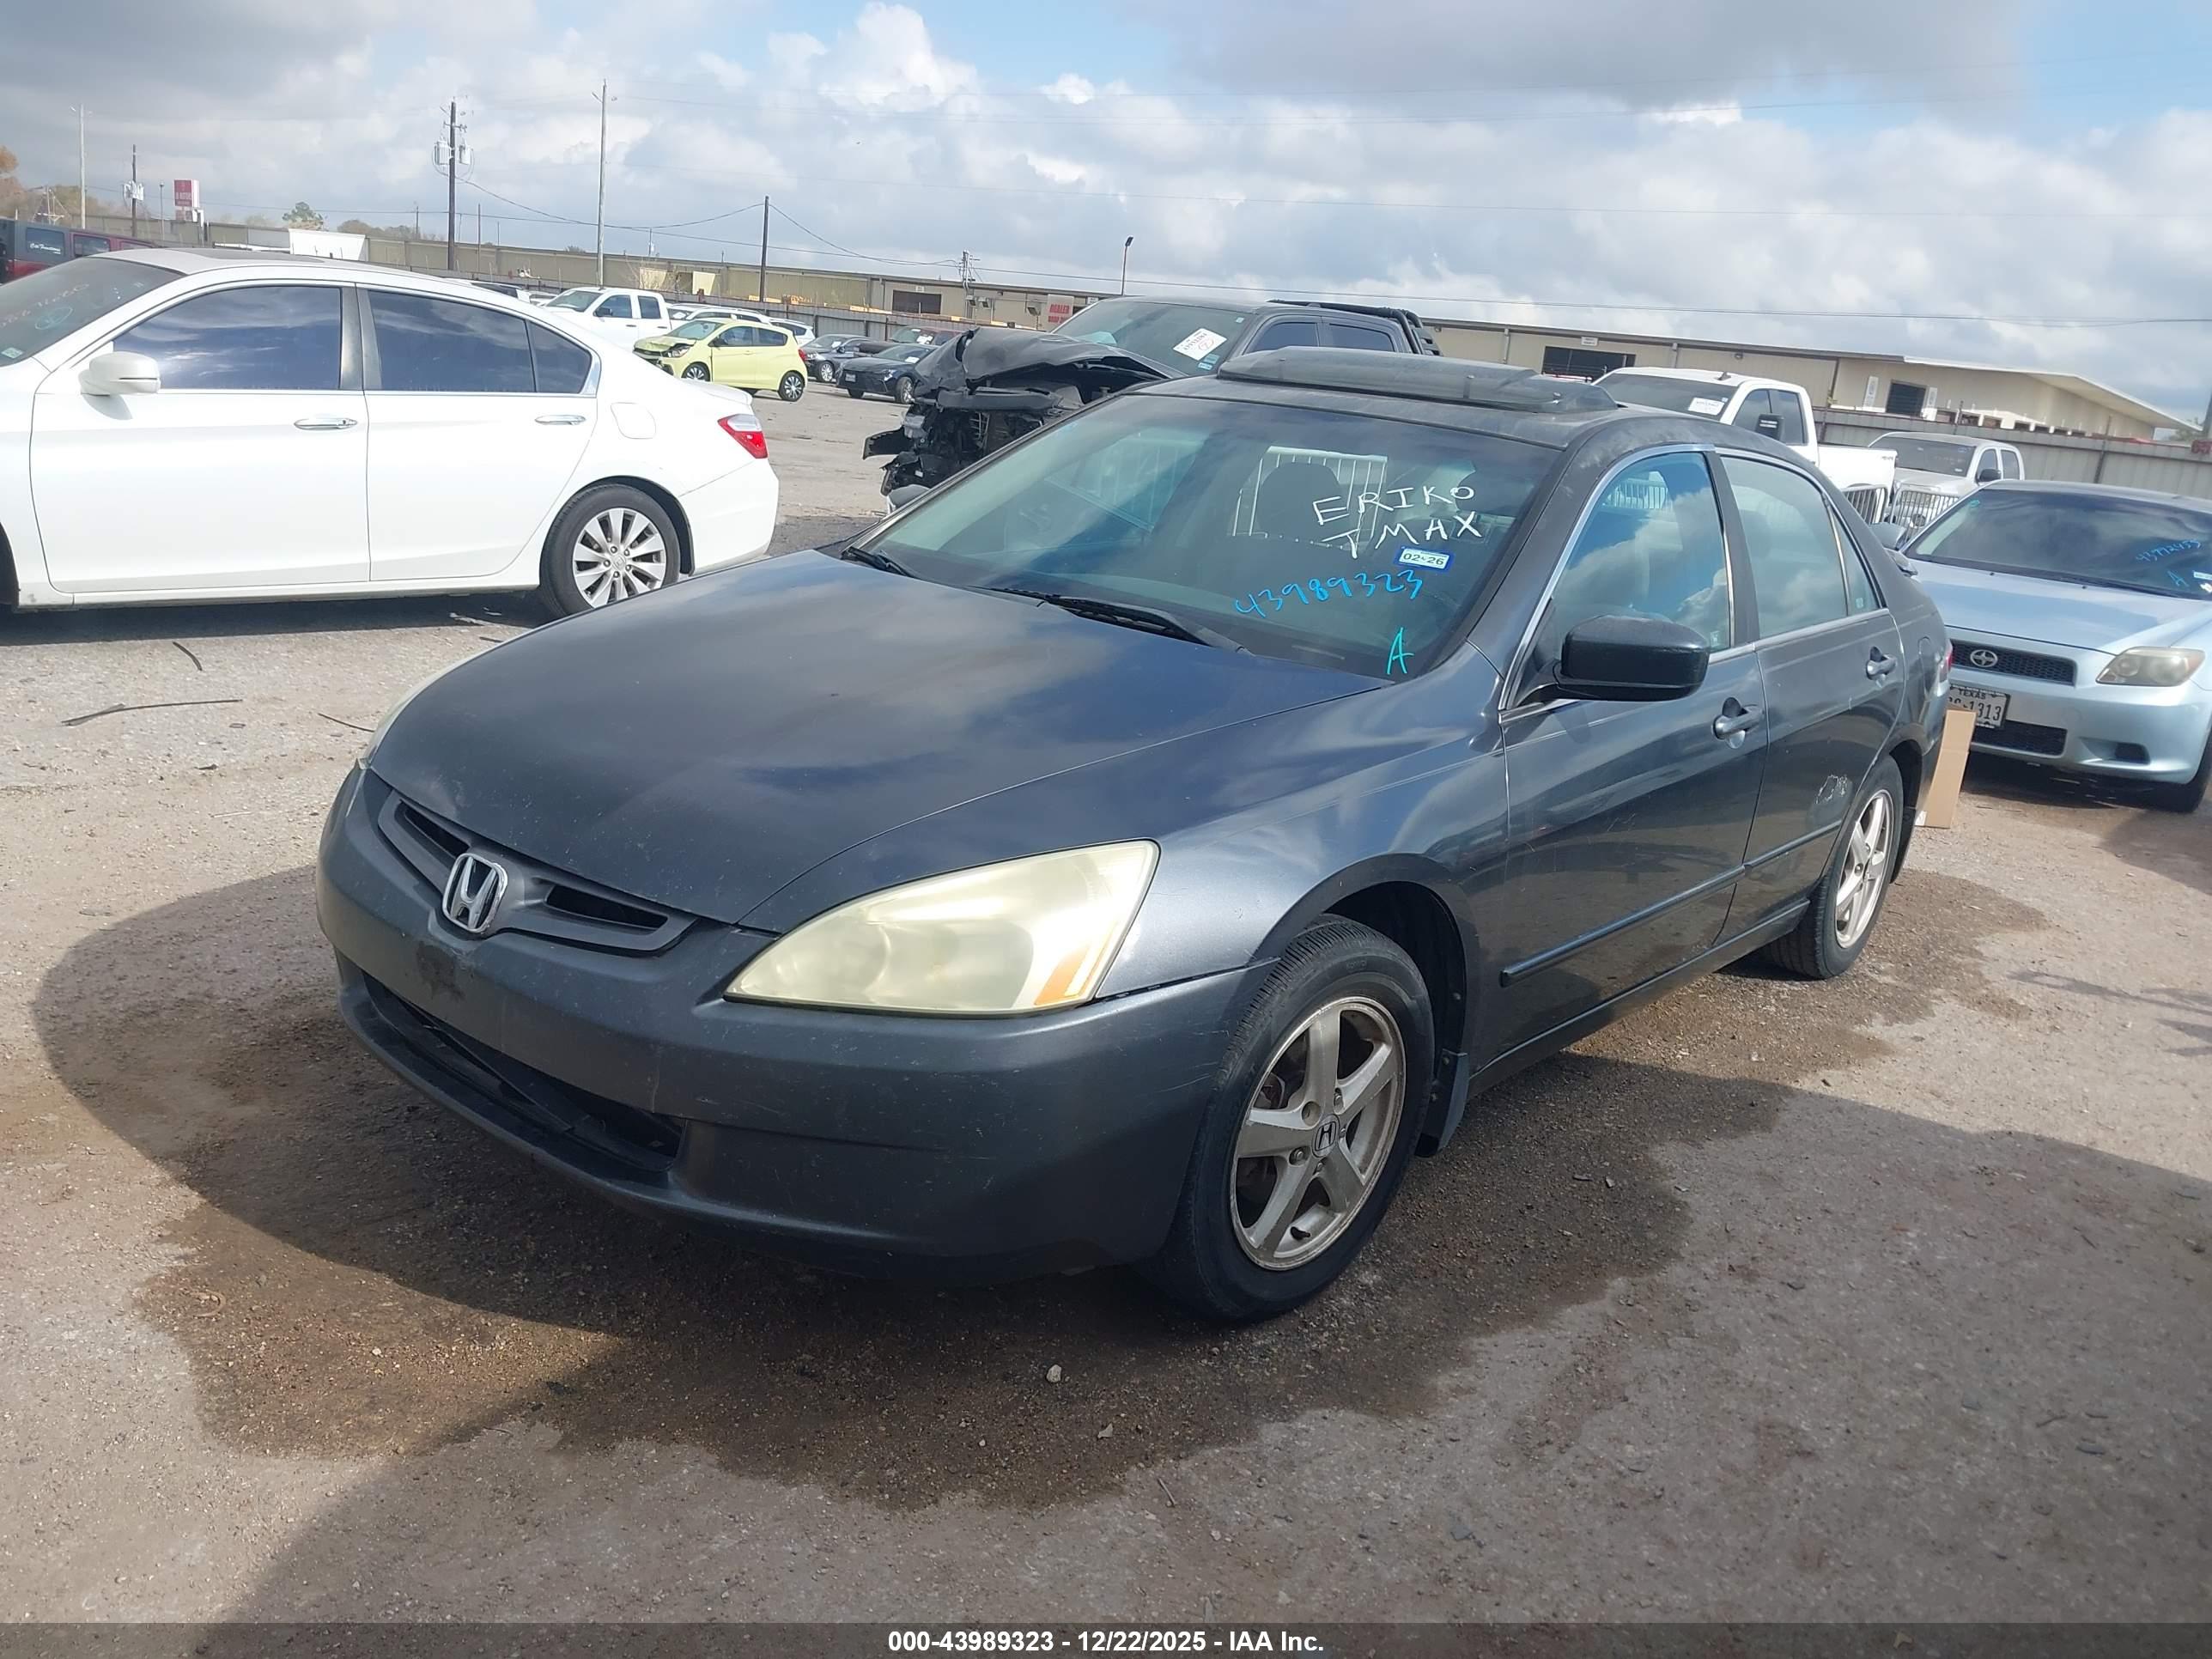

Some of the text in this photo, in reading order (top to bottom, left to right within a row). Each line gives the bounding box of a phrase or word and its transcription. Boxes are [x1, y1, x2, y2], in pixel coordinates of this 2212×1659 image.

[1312, 486, 1475, 526] ERIKO
[1235, 569, 1423, 617] 43989323
[1386, 628, 1414, 675] A
[1958, 689, 1986, 701] TEXAS
